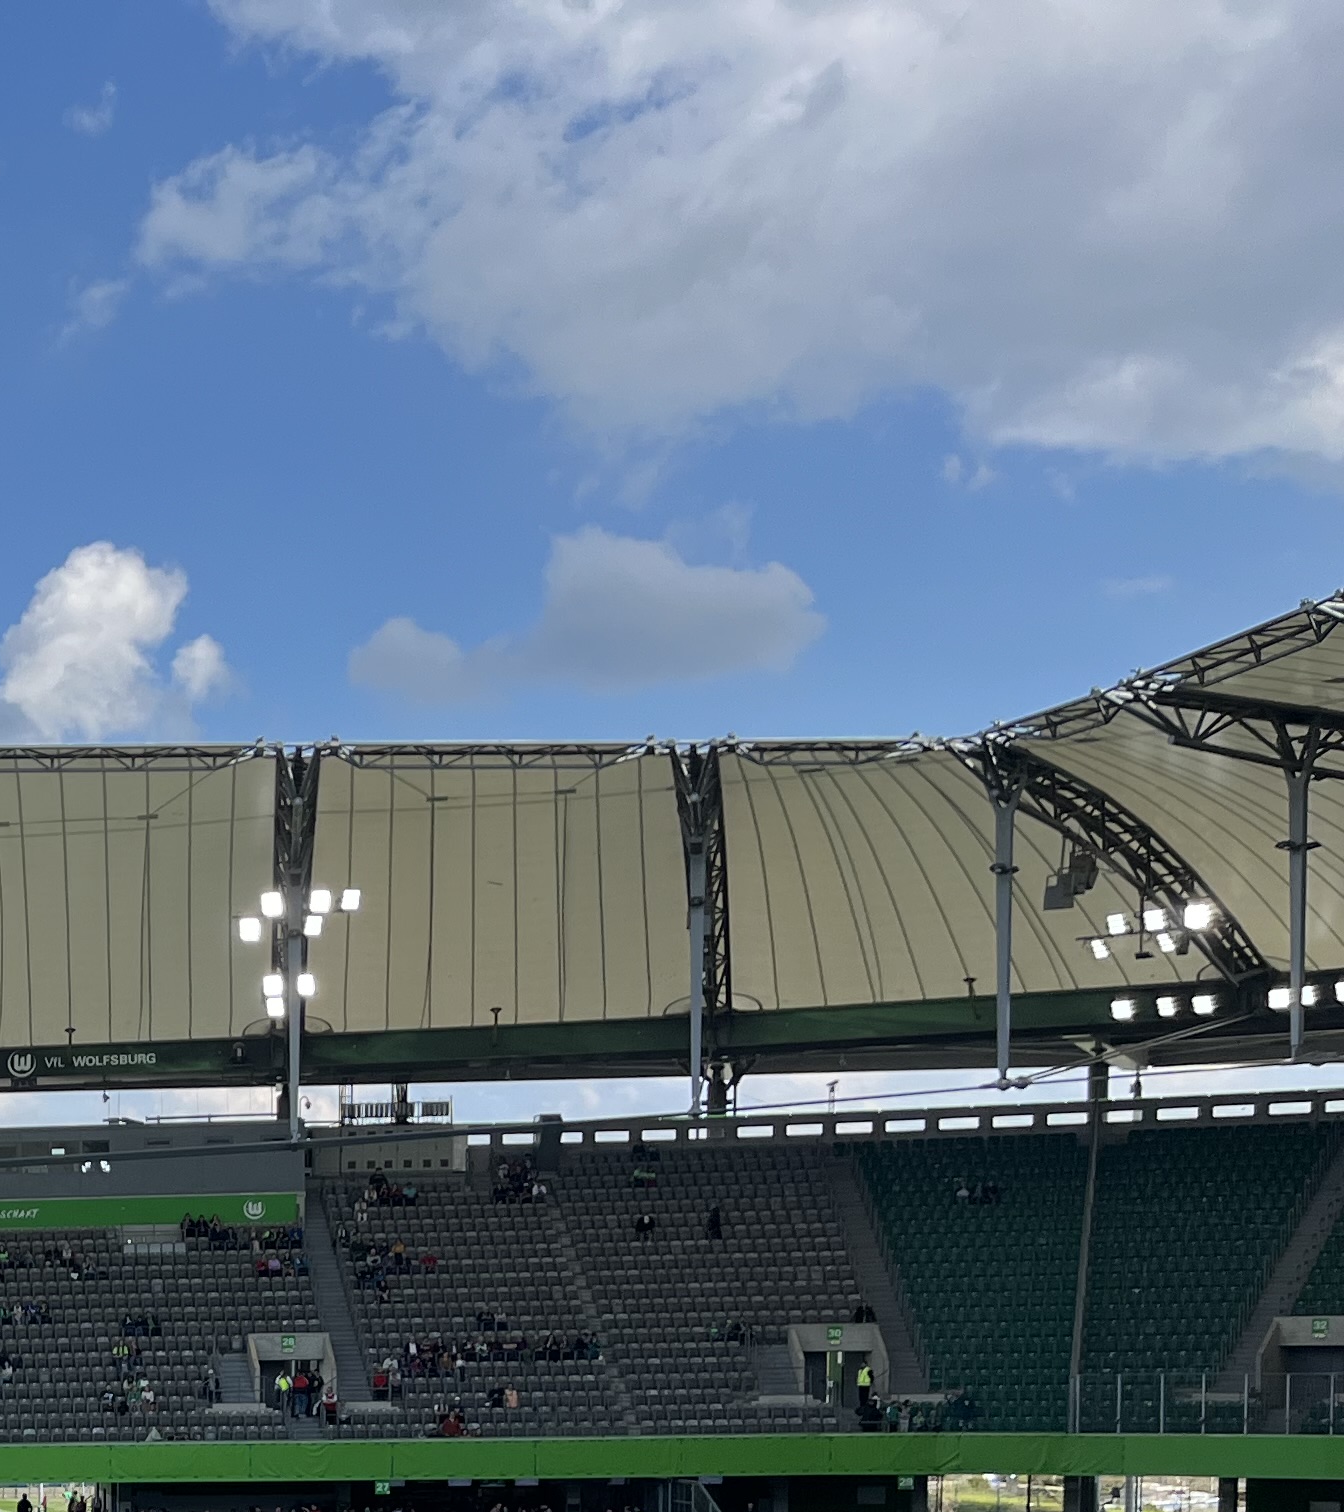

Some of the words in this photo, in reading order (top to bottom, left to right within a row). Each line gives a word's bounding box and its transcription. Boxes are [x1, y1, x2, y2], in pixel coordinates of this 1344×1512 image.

[45, 1056, 65, 1068] VfL
[73, 1053, 156, 1067] WOLFSBURG
[377, 1483, 389, 1491] 27
